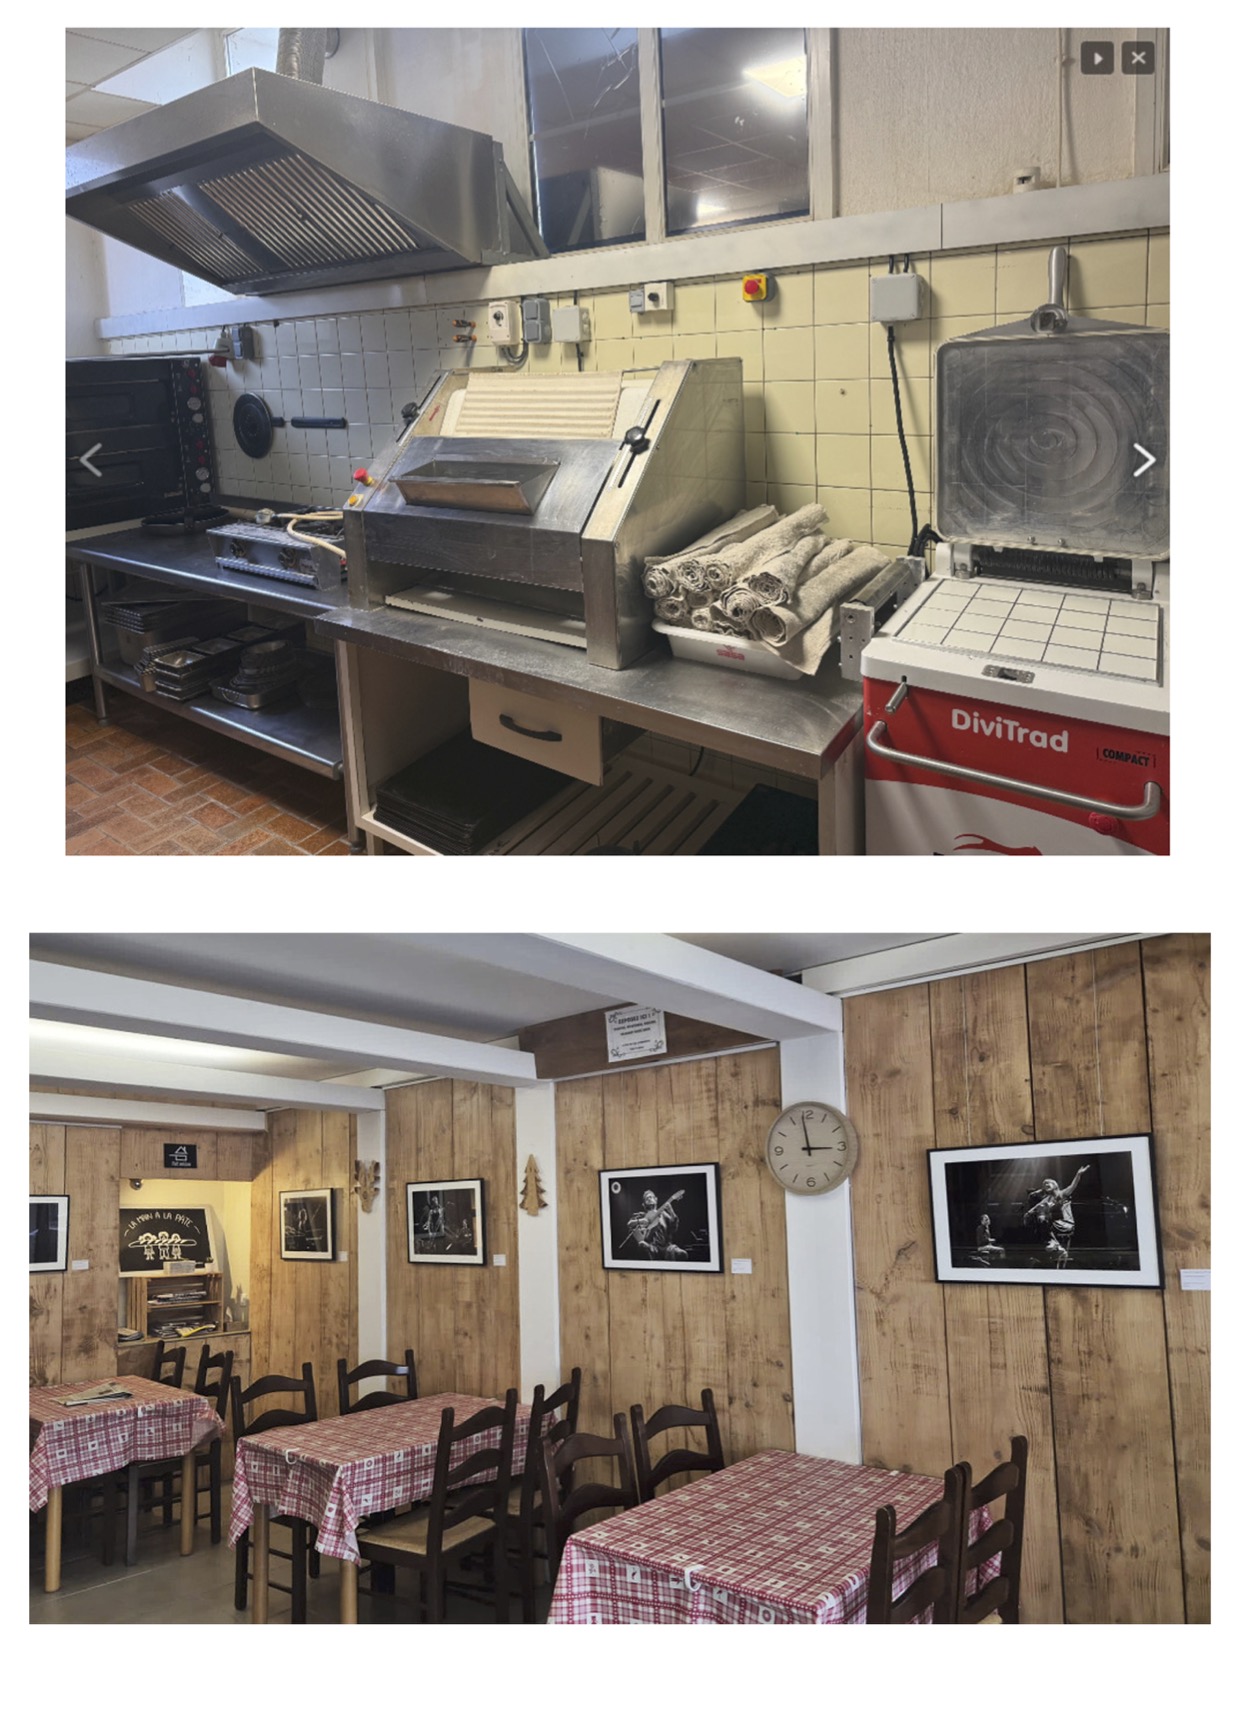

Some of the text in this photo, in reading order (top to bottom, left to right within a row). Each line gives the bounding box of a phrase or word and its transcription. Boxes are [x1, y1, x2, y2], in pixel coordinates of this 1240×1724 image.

[951, 708, 1069, 753] DiviTrad
[1102, 748, 1150, 767] COMPACT
[774, 1146, 784, 1156] 9
[837, 1141, 847, 1151] 3
[806, 1177, 816, 1187] 6
[128, 1221, 138, 1229] LA
[163, 1212, 172, 1220] LA
